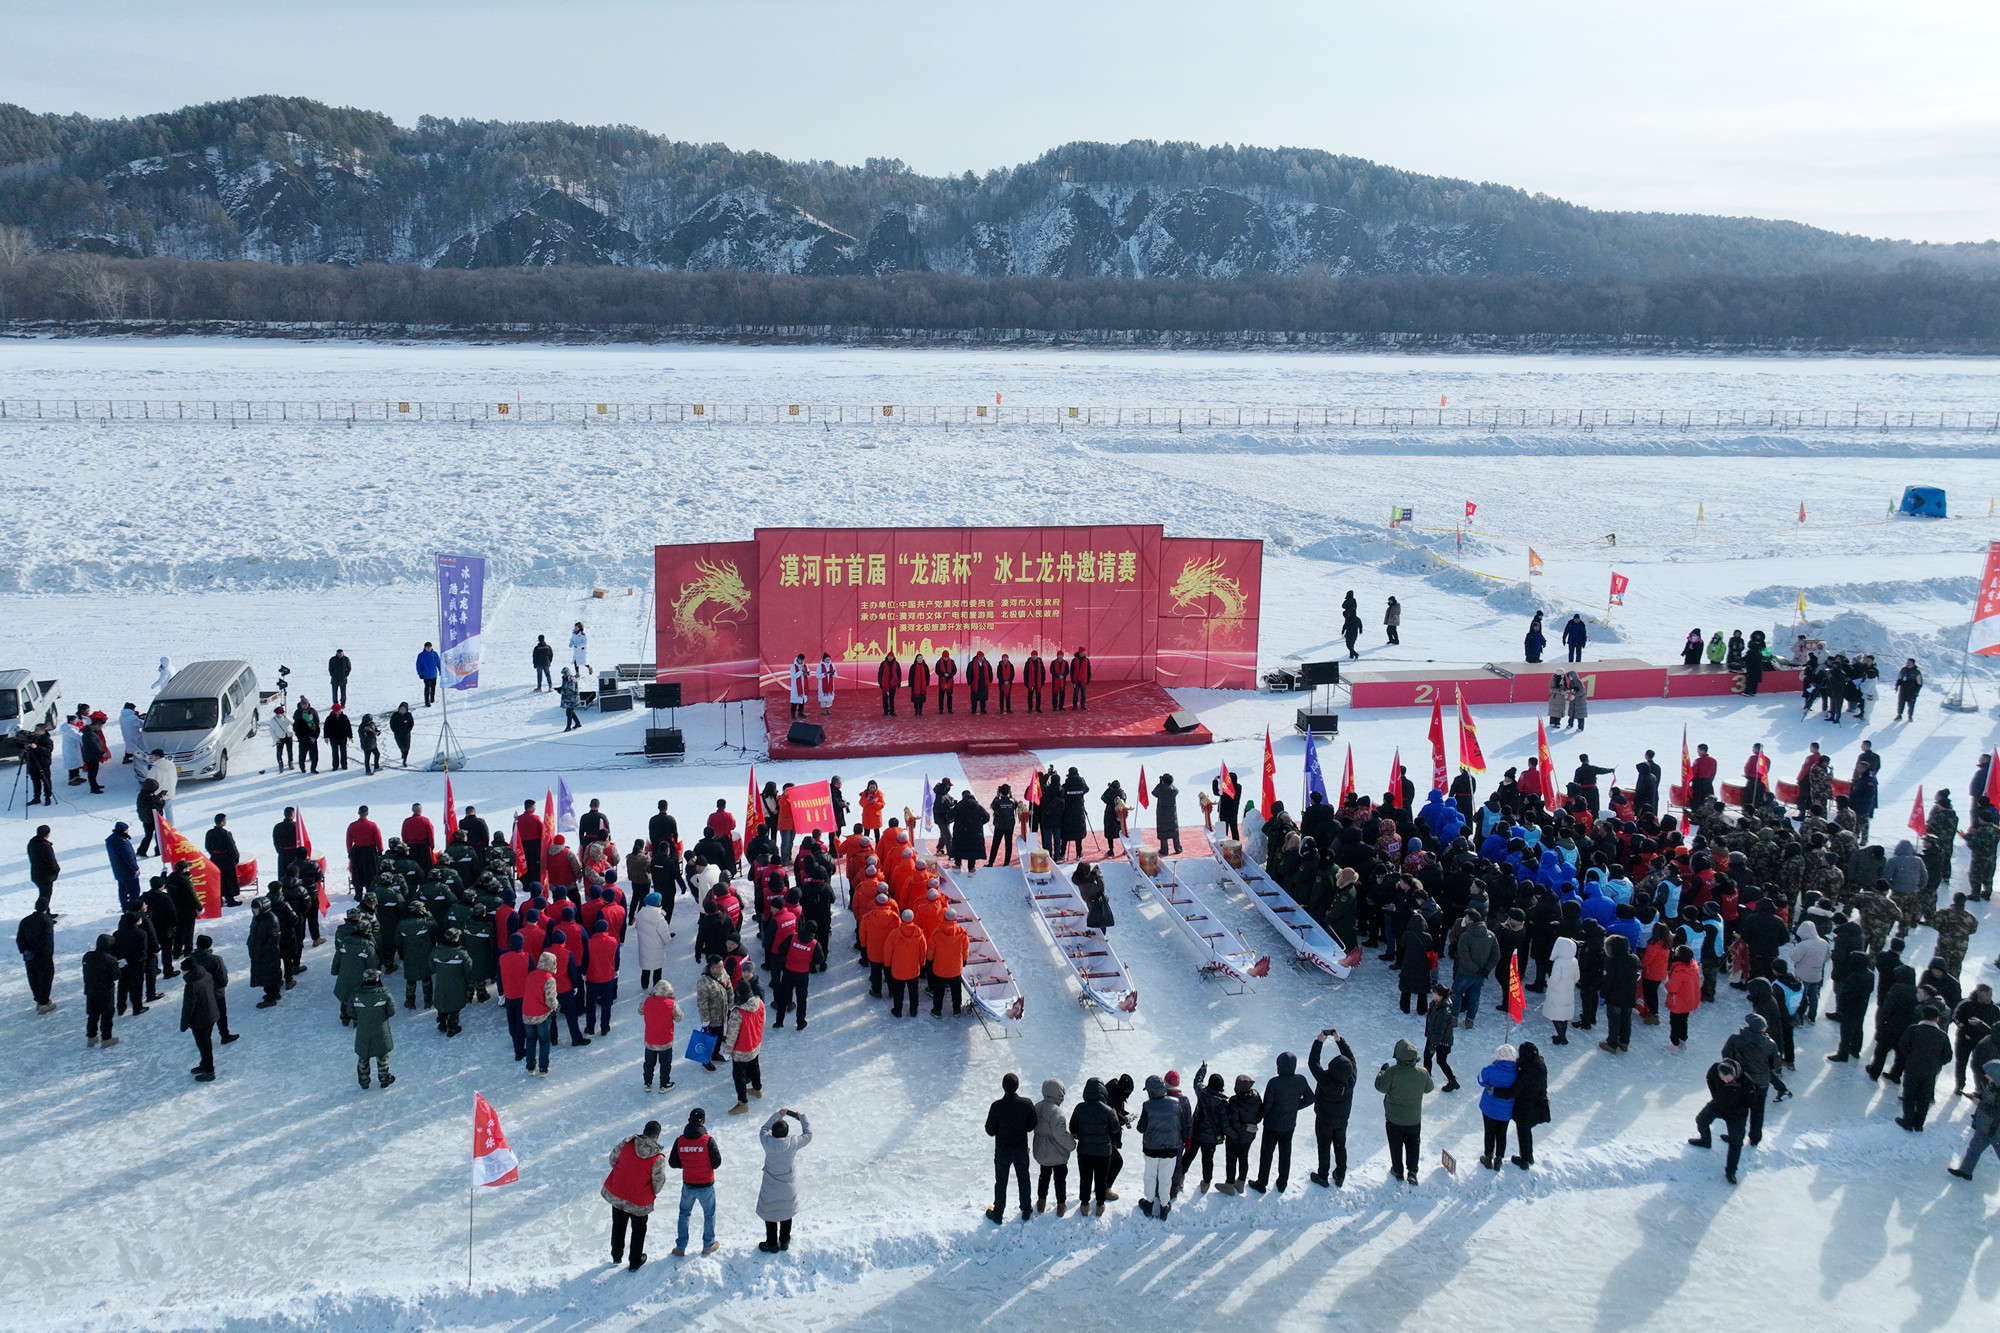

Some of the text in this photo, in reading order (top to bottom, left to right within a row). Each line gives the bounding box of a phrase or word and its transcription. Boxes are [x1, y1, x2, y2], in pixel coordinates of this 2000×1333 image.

[459, 565, 471, 625] 冰上龙舟
[1001, 598, 1061, 608] 漠河市人民政府
[1001, 609, 1061, 619] 北极镇人民政府
[899, 622, 995, 633] 漠河北极旅游开发有限公司
[1582, 675, 1597, 698] 1
[1731, 675, 1747, 693] 3
[1415, 684, 1433, 704] 2
